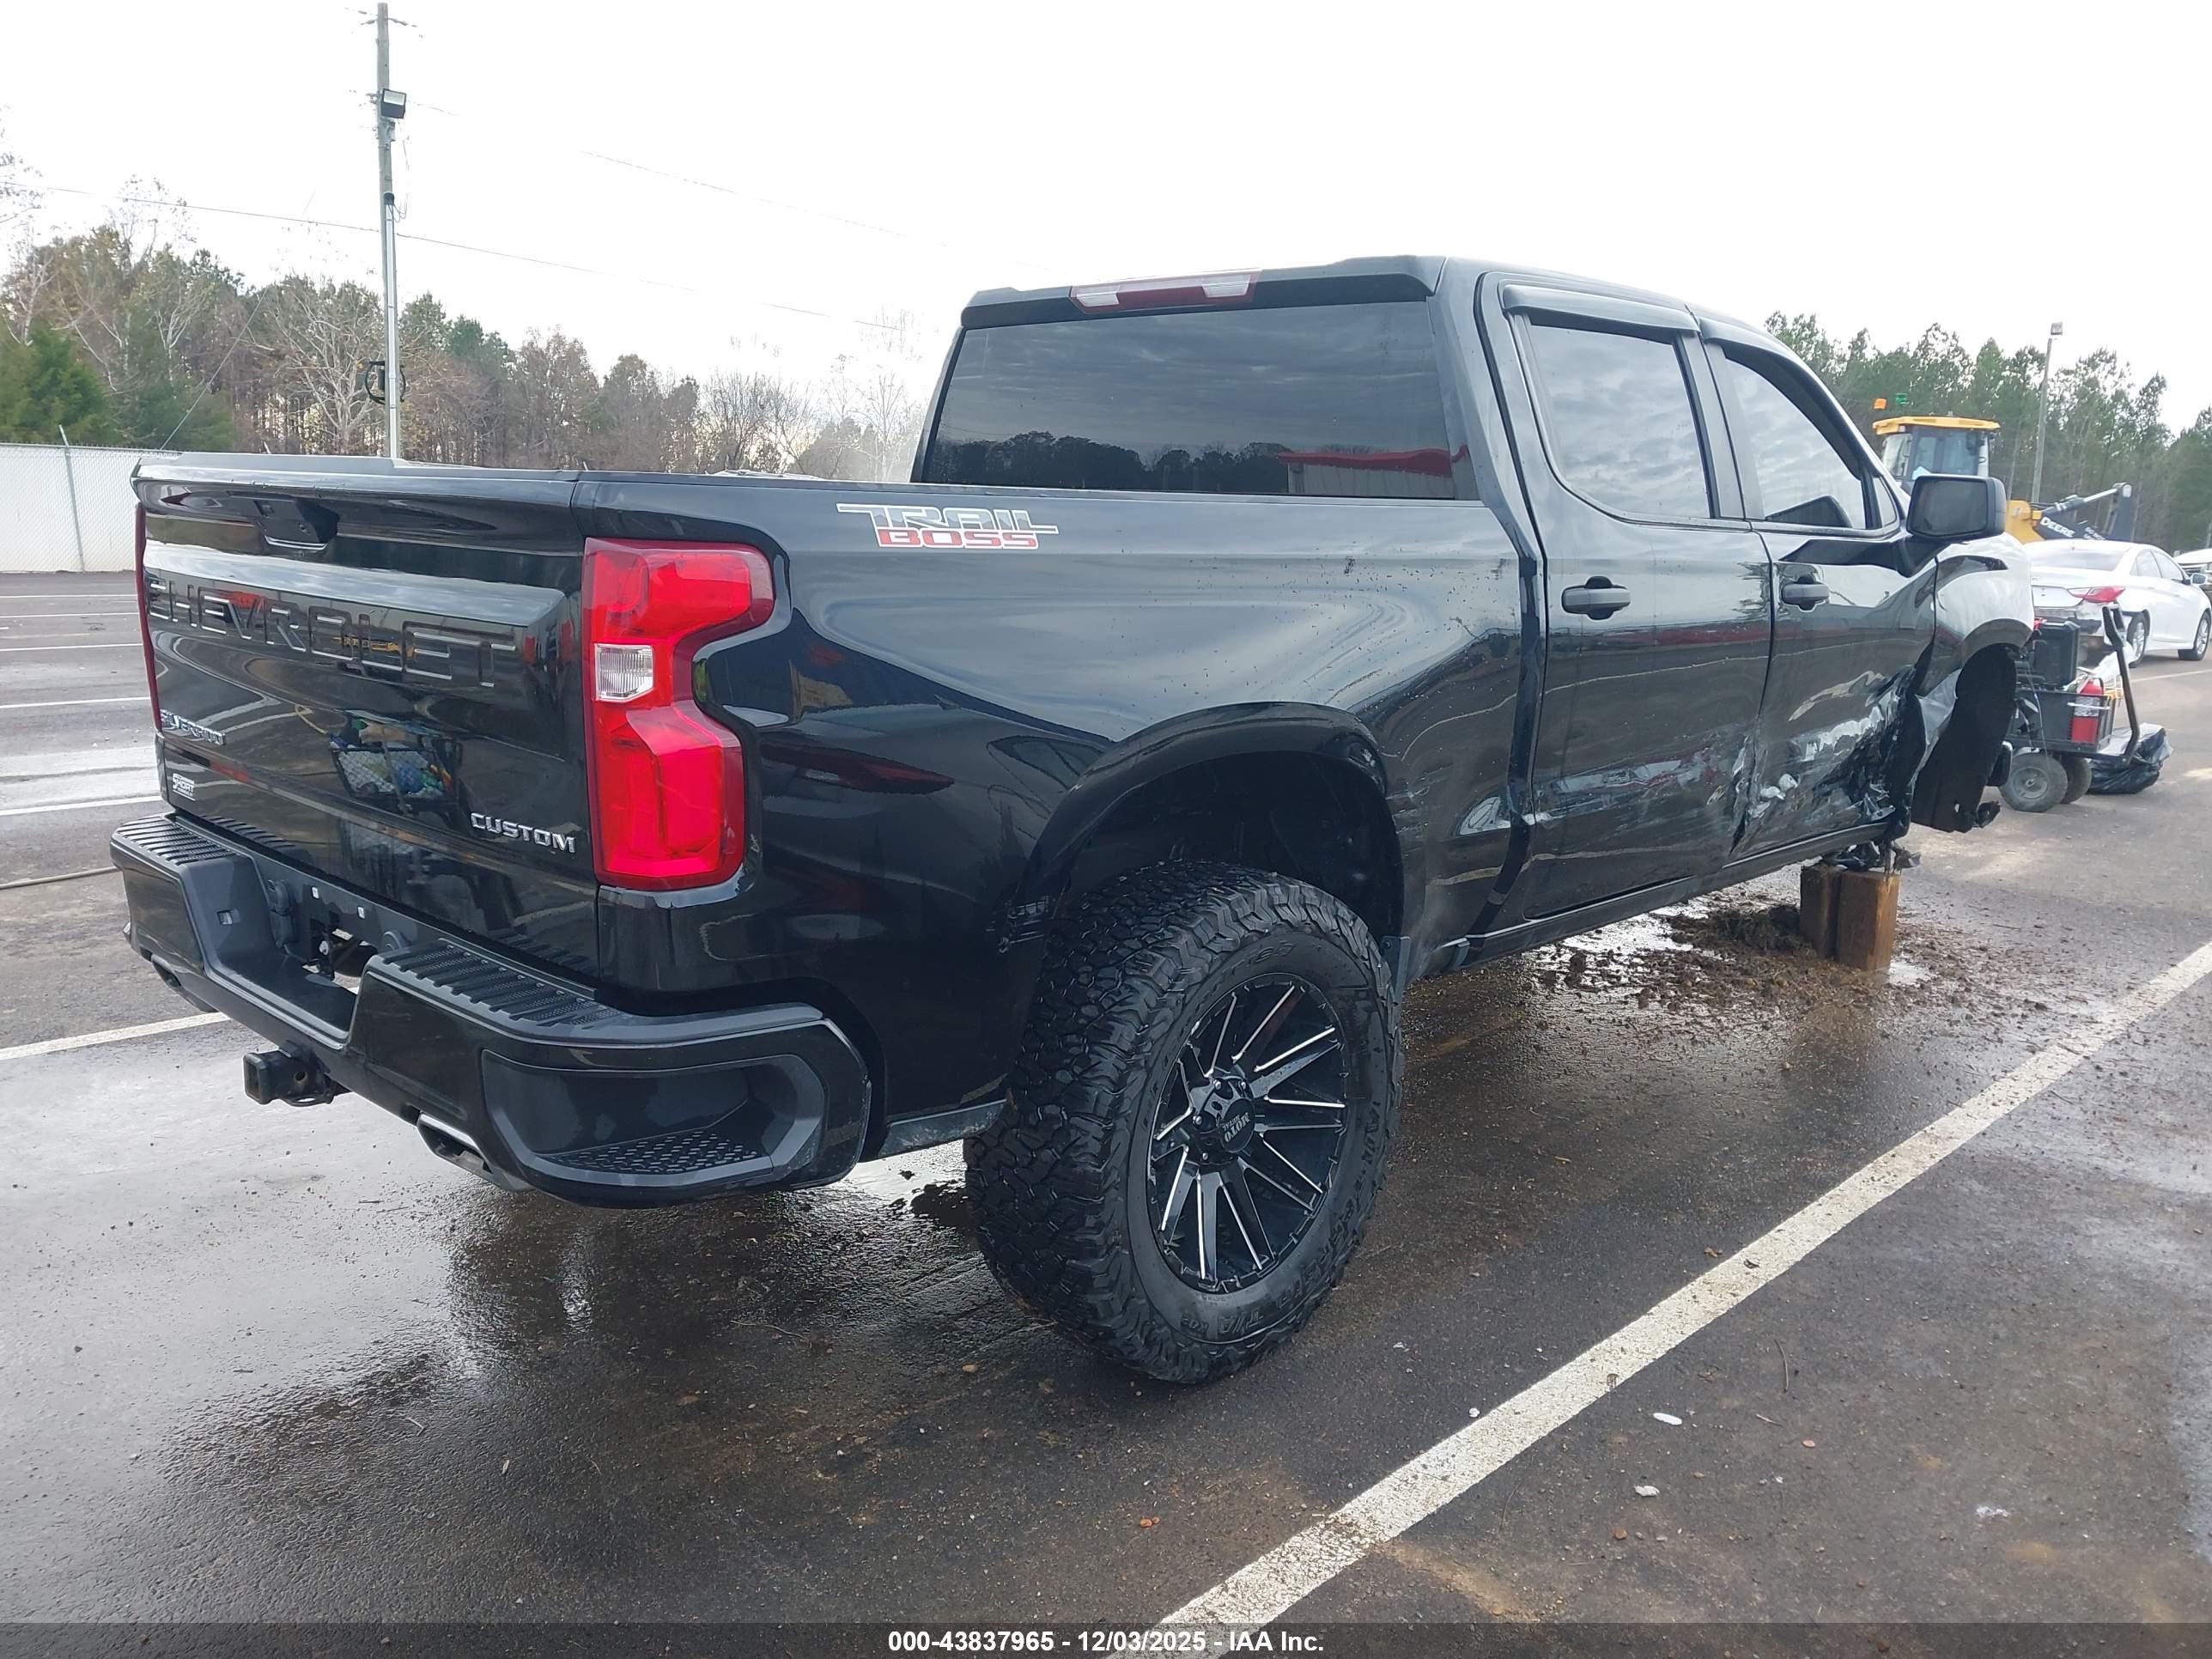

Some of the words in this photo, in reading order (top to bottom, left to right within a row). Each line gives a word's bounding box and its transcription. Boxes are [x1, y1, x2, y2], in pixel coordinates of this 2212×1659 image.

[836, 503, 1060, 535] TRAIL
[2039, 516, 2075, 538] DEERE
[877, 527, 1039, 550] BOSS
[147, 572, 516, 687] CHEVROLET
[470, 812, 575, 854] CUSTOM
[1224, 1112, 1251, 1143] MOTO
